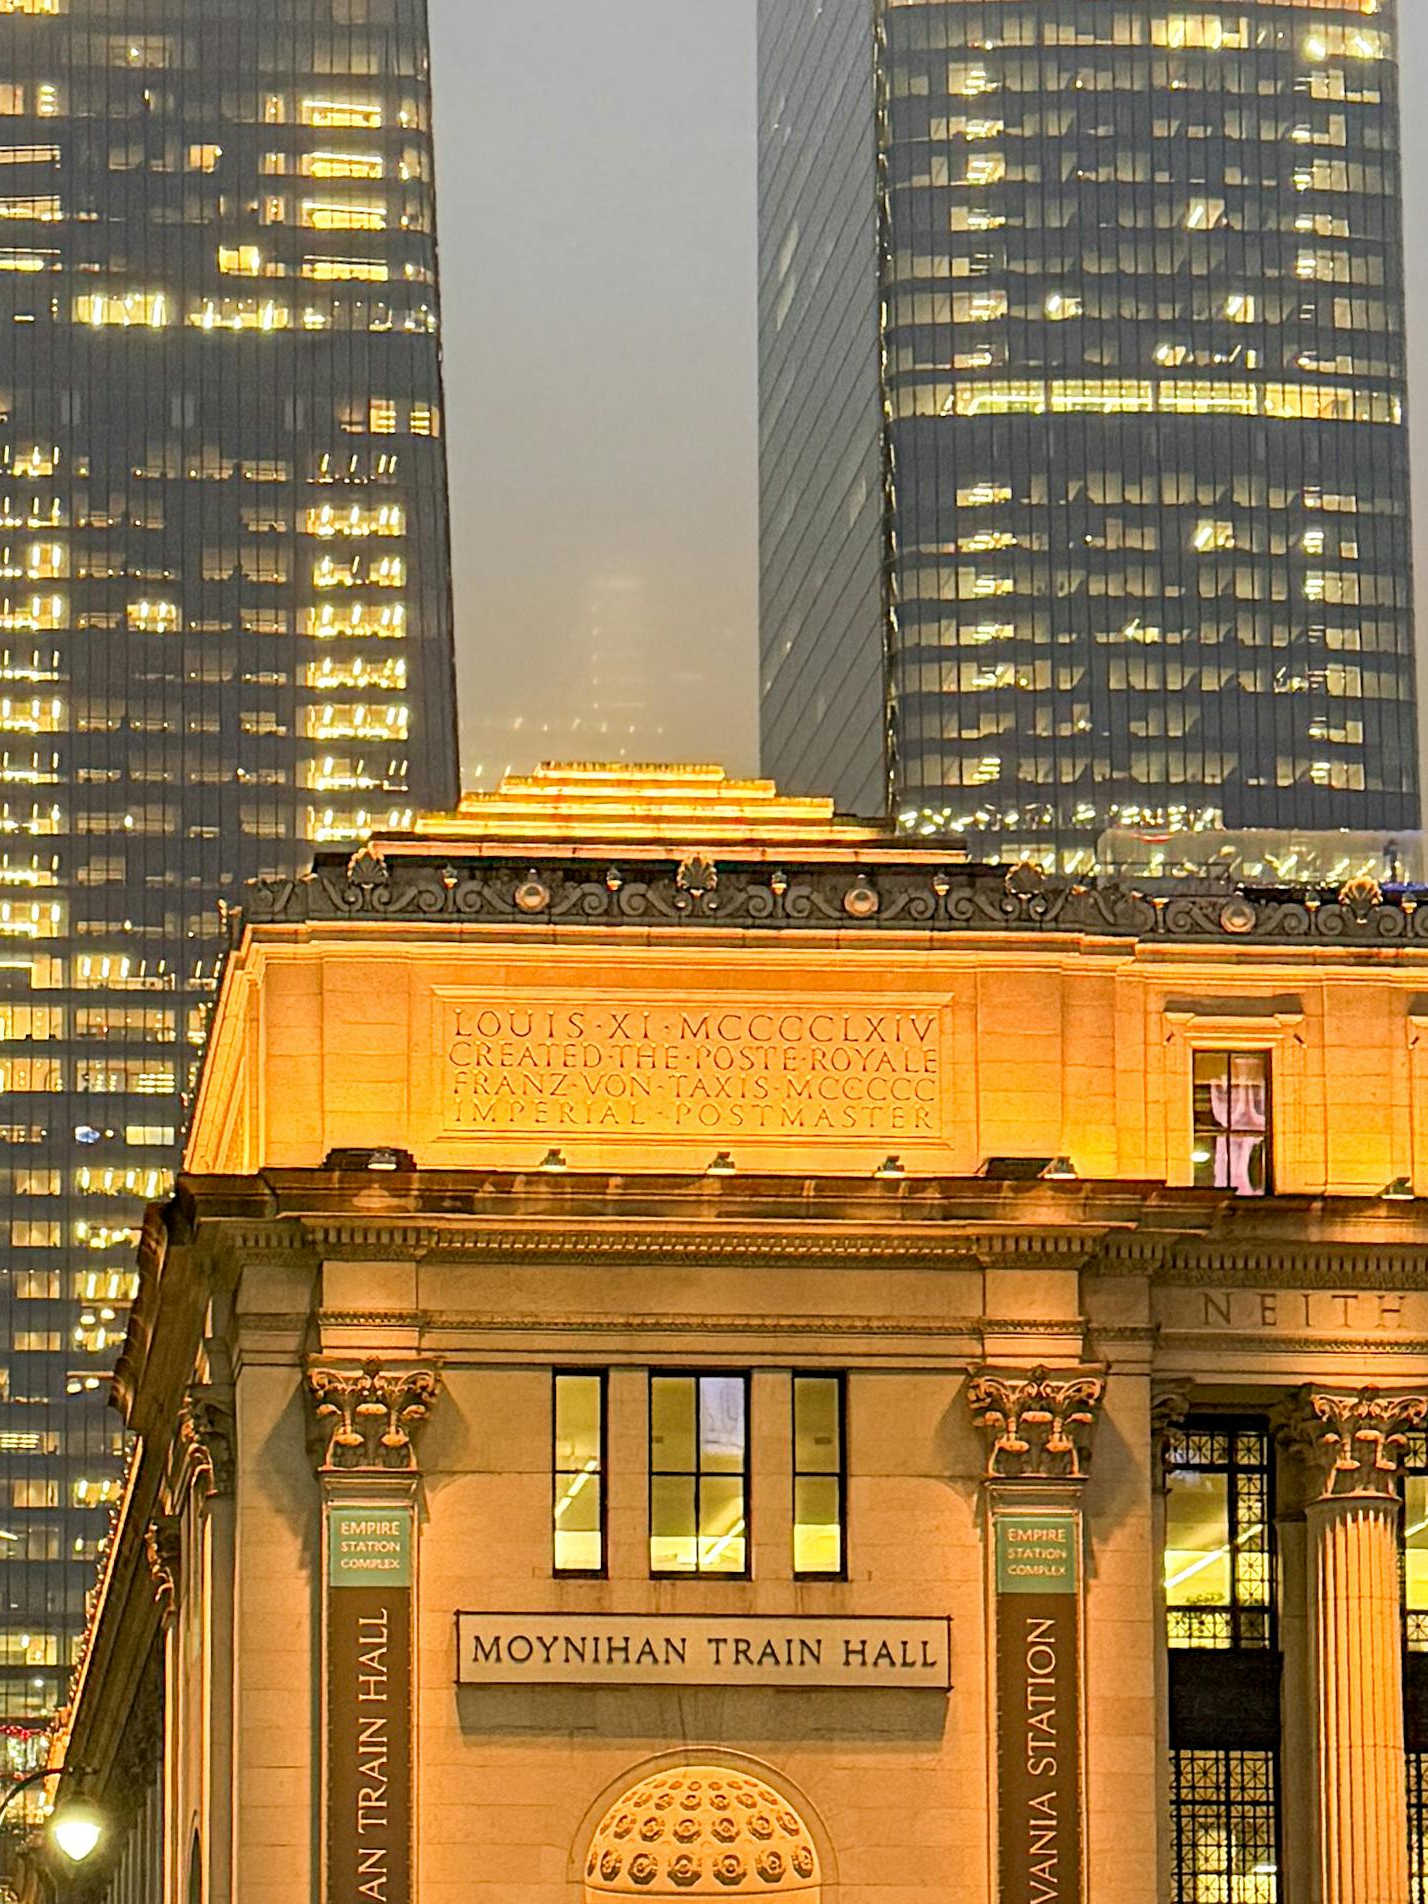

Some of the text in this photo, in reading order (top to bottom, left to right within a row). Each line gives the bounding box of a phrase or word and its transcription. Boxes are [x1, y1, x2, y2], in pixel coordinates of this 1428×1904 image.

[454, 1008, 937, 1042] LOUIS XI MCCCCLXIV
[448, 1040, 938, 1073] CREATED THE POSTE ROYALE
[453, 1070, 936, 1102] FRANZ VON TAXIS MCCCCC
[454, 1098, 934, 1129] IMPERIAL POSTMASTER
[340, 1520, 401, 1536] EMPIRE
[1007, 1527, 1067, 1543] EMPIRE
[340, 1540, 401, 1553] STATION
[1007, 1546, 1068, 1560] STATION
[340, 1558, 400, 1570] COMPLEX
[1007, 1564, 1066, 1576] COMPLEX
[358, 1607, 388, 1702] HALL
[471, 1634, 938, 1669] MOYNIHAN TRAIN HALL
[1026, 1617, 1058, 1777] STATION
[357, 1717, 388, 1835] TRAIN
